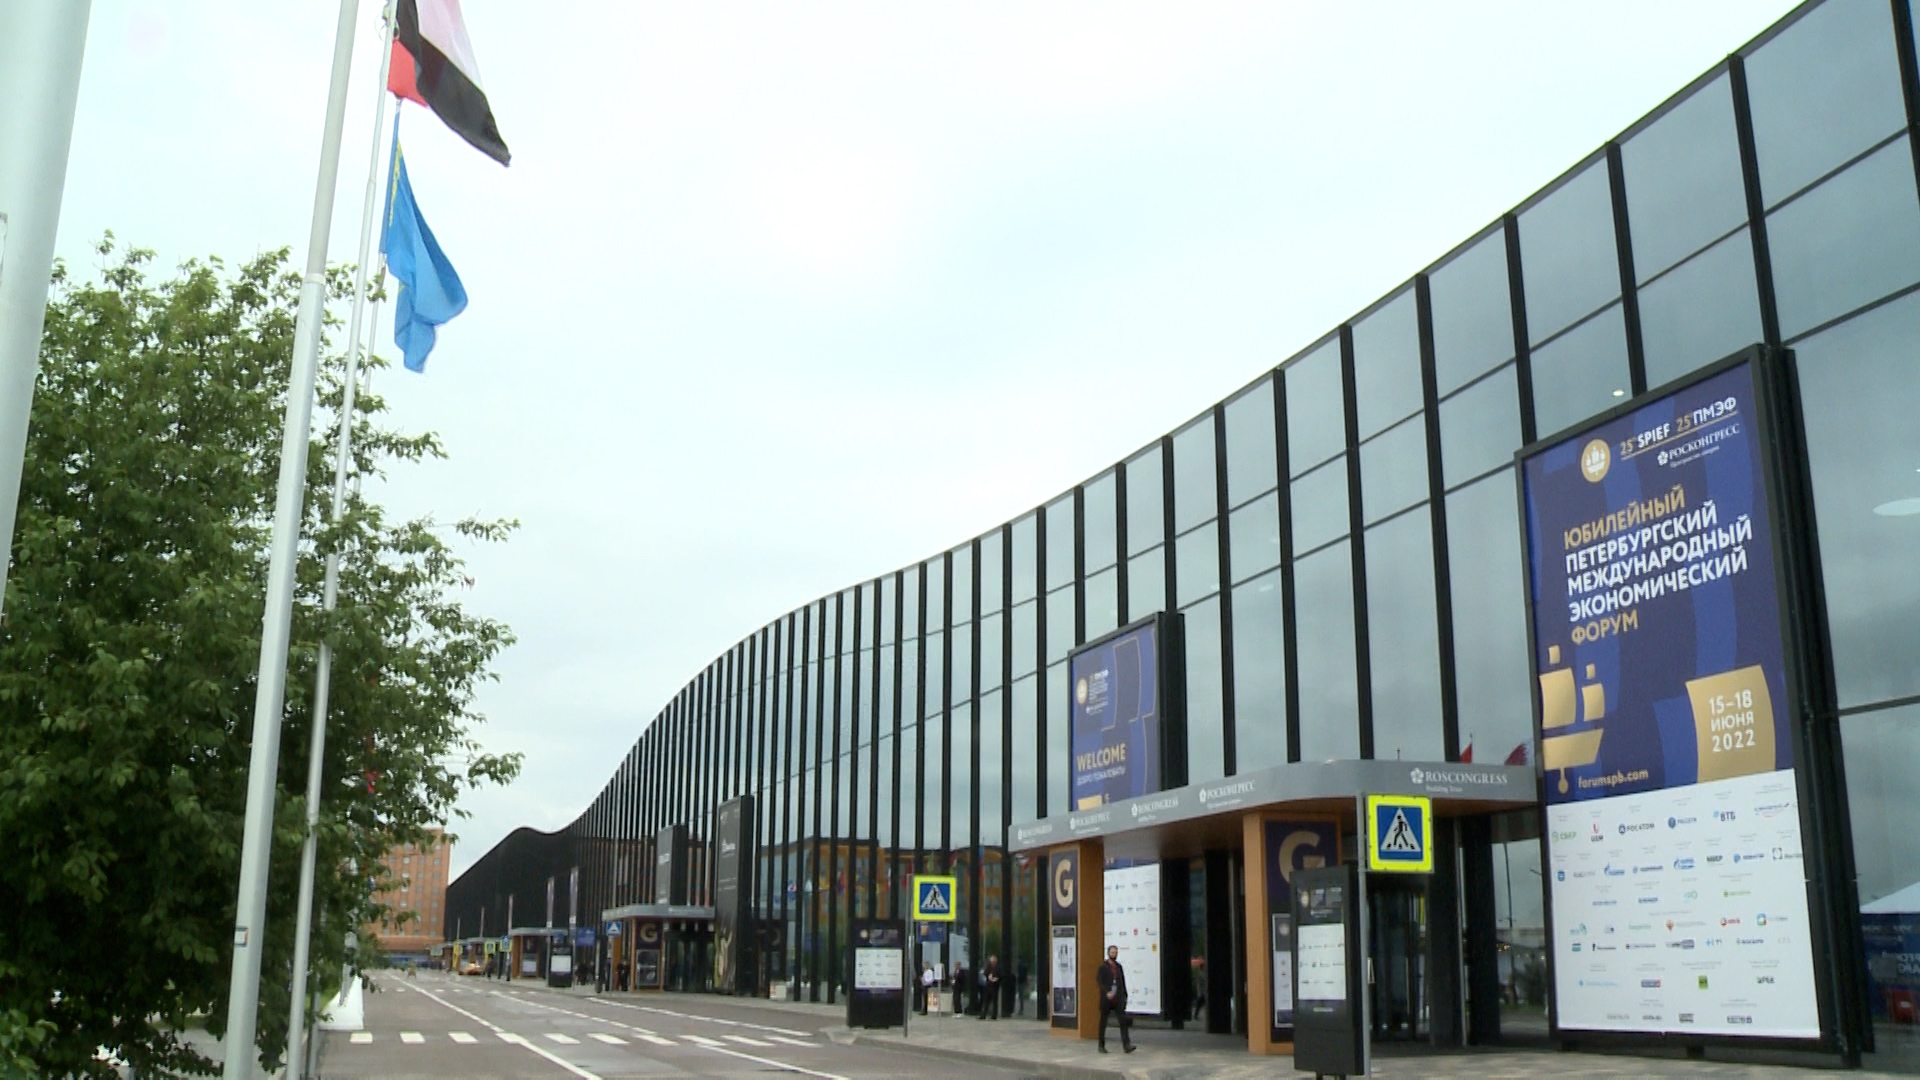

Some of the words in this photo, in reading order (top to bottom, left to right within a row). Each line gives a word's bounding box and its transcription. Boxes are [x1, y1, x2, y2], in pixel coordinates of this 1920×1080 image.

[1693, 397, 1737, 425] ПМЭФ
[1637, 423, 1670, 448] SPIEF
[1669, 423, 1740, 460] РОСКОНГРЕСС
[1564, 484, 1685, 549] ЮБИЛЕЙНЫЙ
[1566, 500, 1717, 573] ПЕТЕРБУРГСКИЙ
[1568, 514, 1752, 596] МЕЖДУНАРОДНЫЙ
[1568, 545, 1747, 622] ЭКОНОМИЧЕСКИЙ
[1571, 609, 1638, 644] ФОРУМ
[1711, 711, 1754, 731] ИЮНЯ
[1712, 729, 1755, 752] 2022
[1077, 743, 1126, 772] WELCOME
[1425, 771, 1508, 784] ROSCONGRESS
[1578, 768, 1649, 789] forumspb.com
[1055, 859, 1074, 908] G
[640, 923, 658, 943] G
